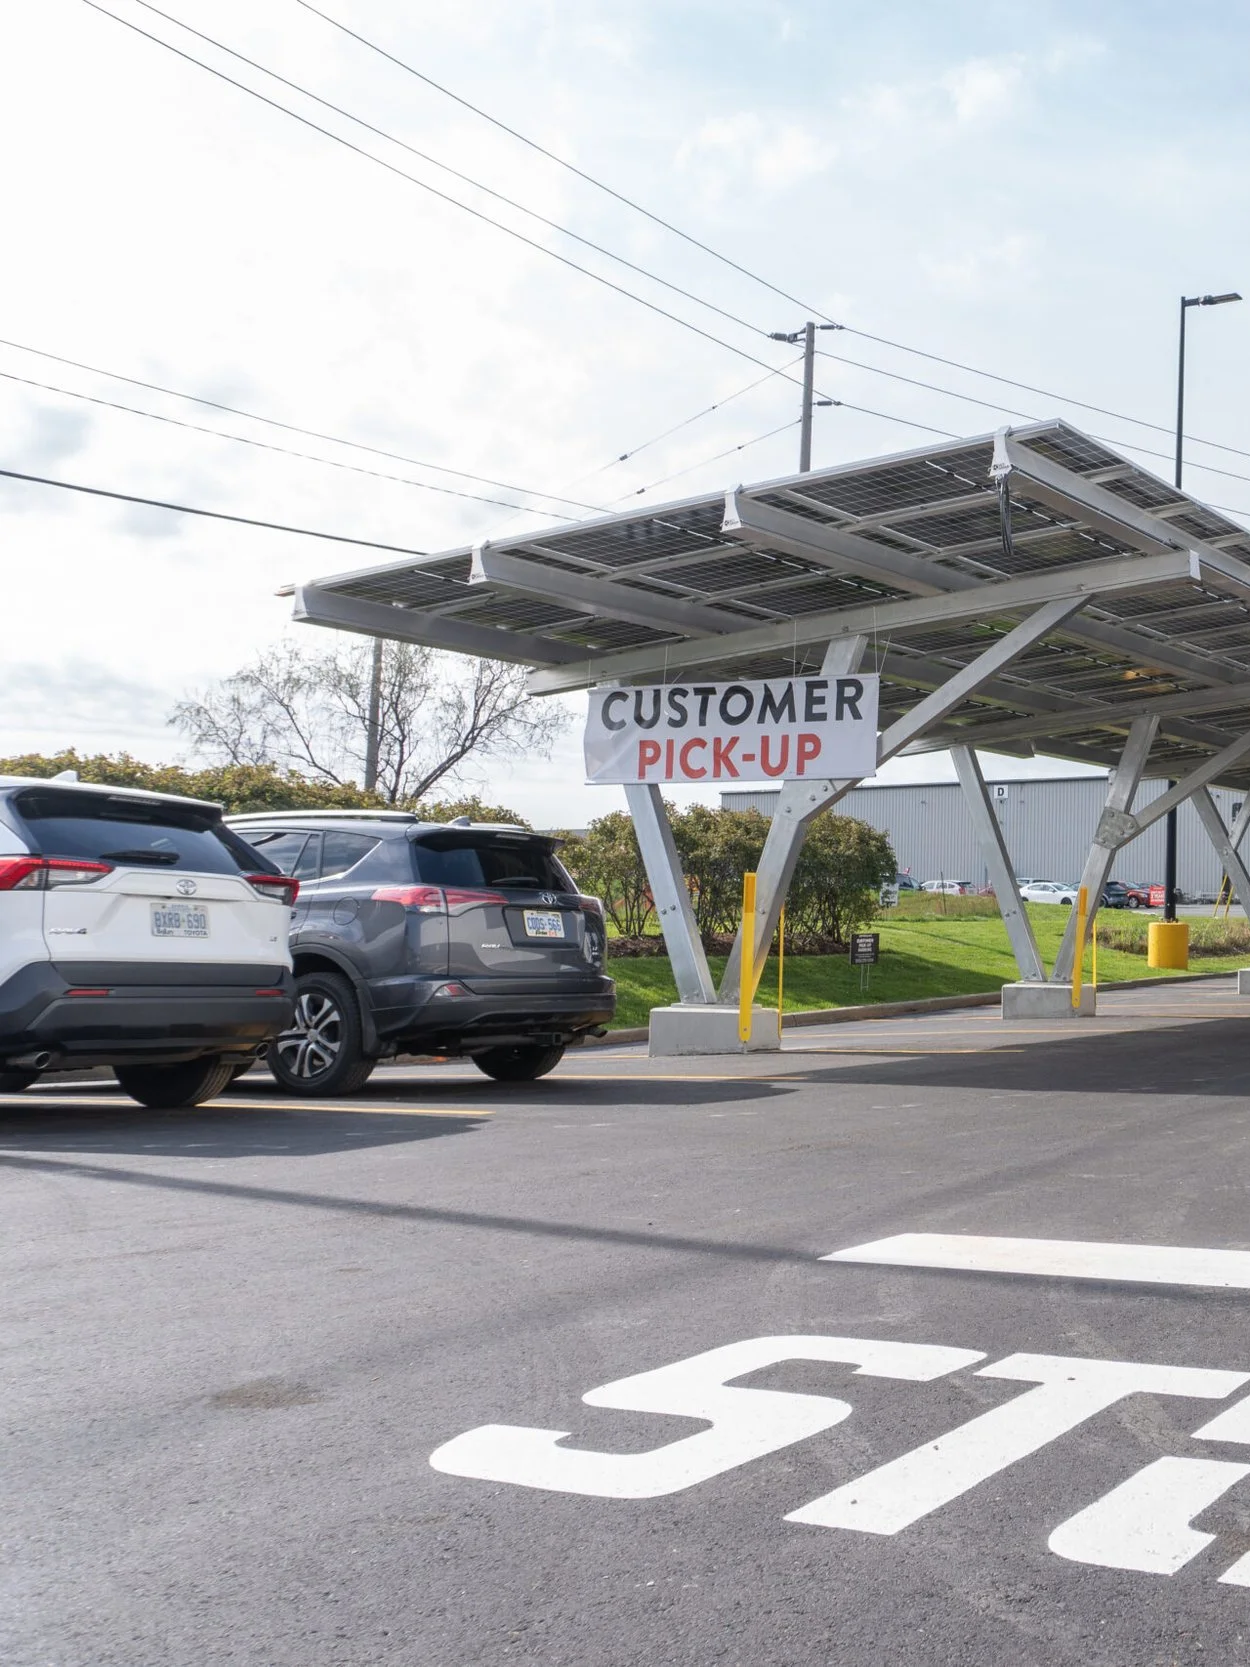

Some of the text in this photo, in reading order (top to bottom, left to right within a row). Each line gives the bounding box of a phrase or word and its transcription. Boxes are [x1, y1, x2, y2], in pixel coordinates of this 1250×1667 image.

[601, 678, 864, 731] CUSTOMER
[637, 733, 822, 780] PICK-UP
[997, 787, 1005, 796] D
